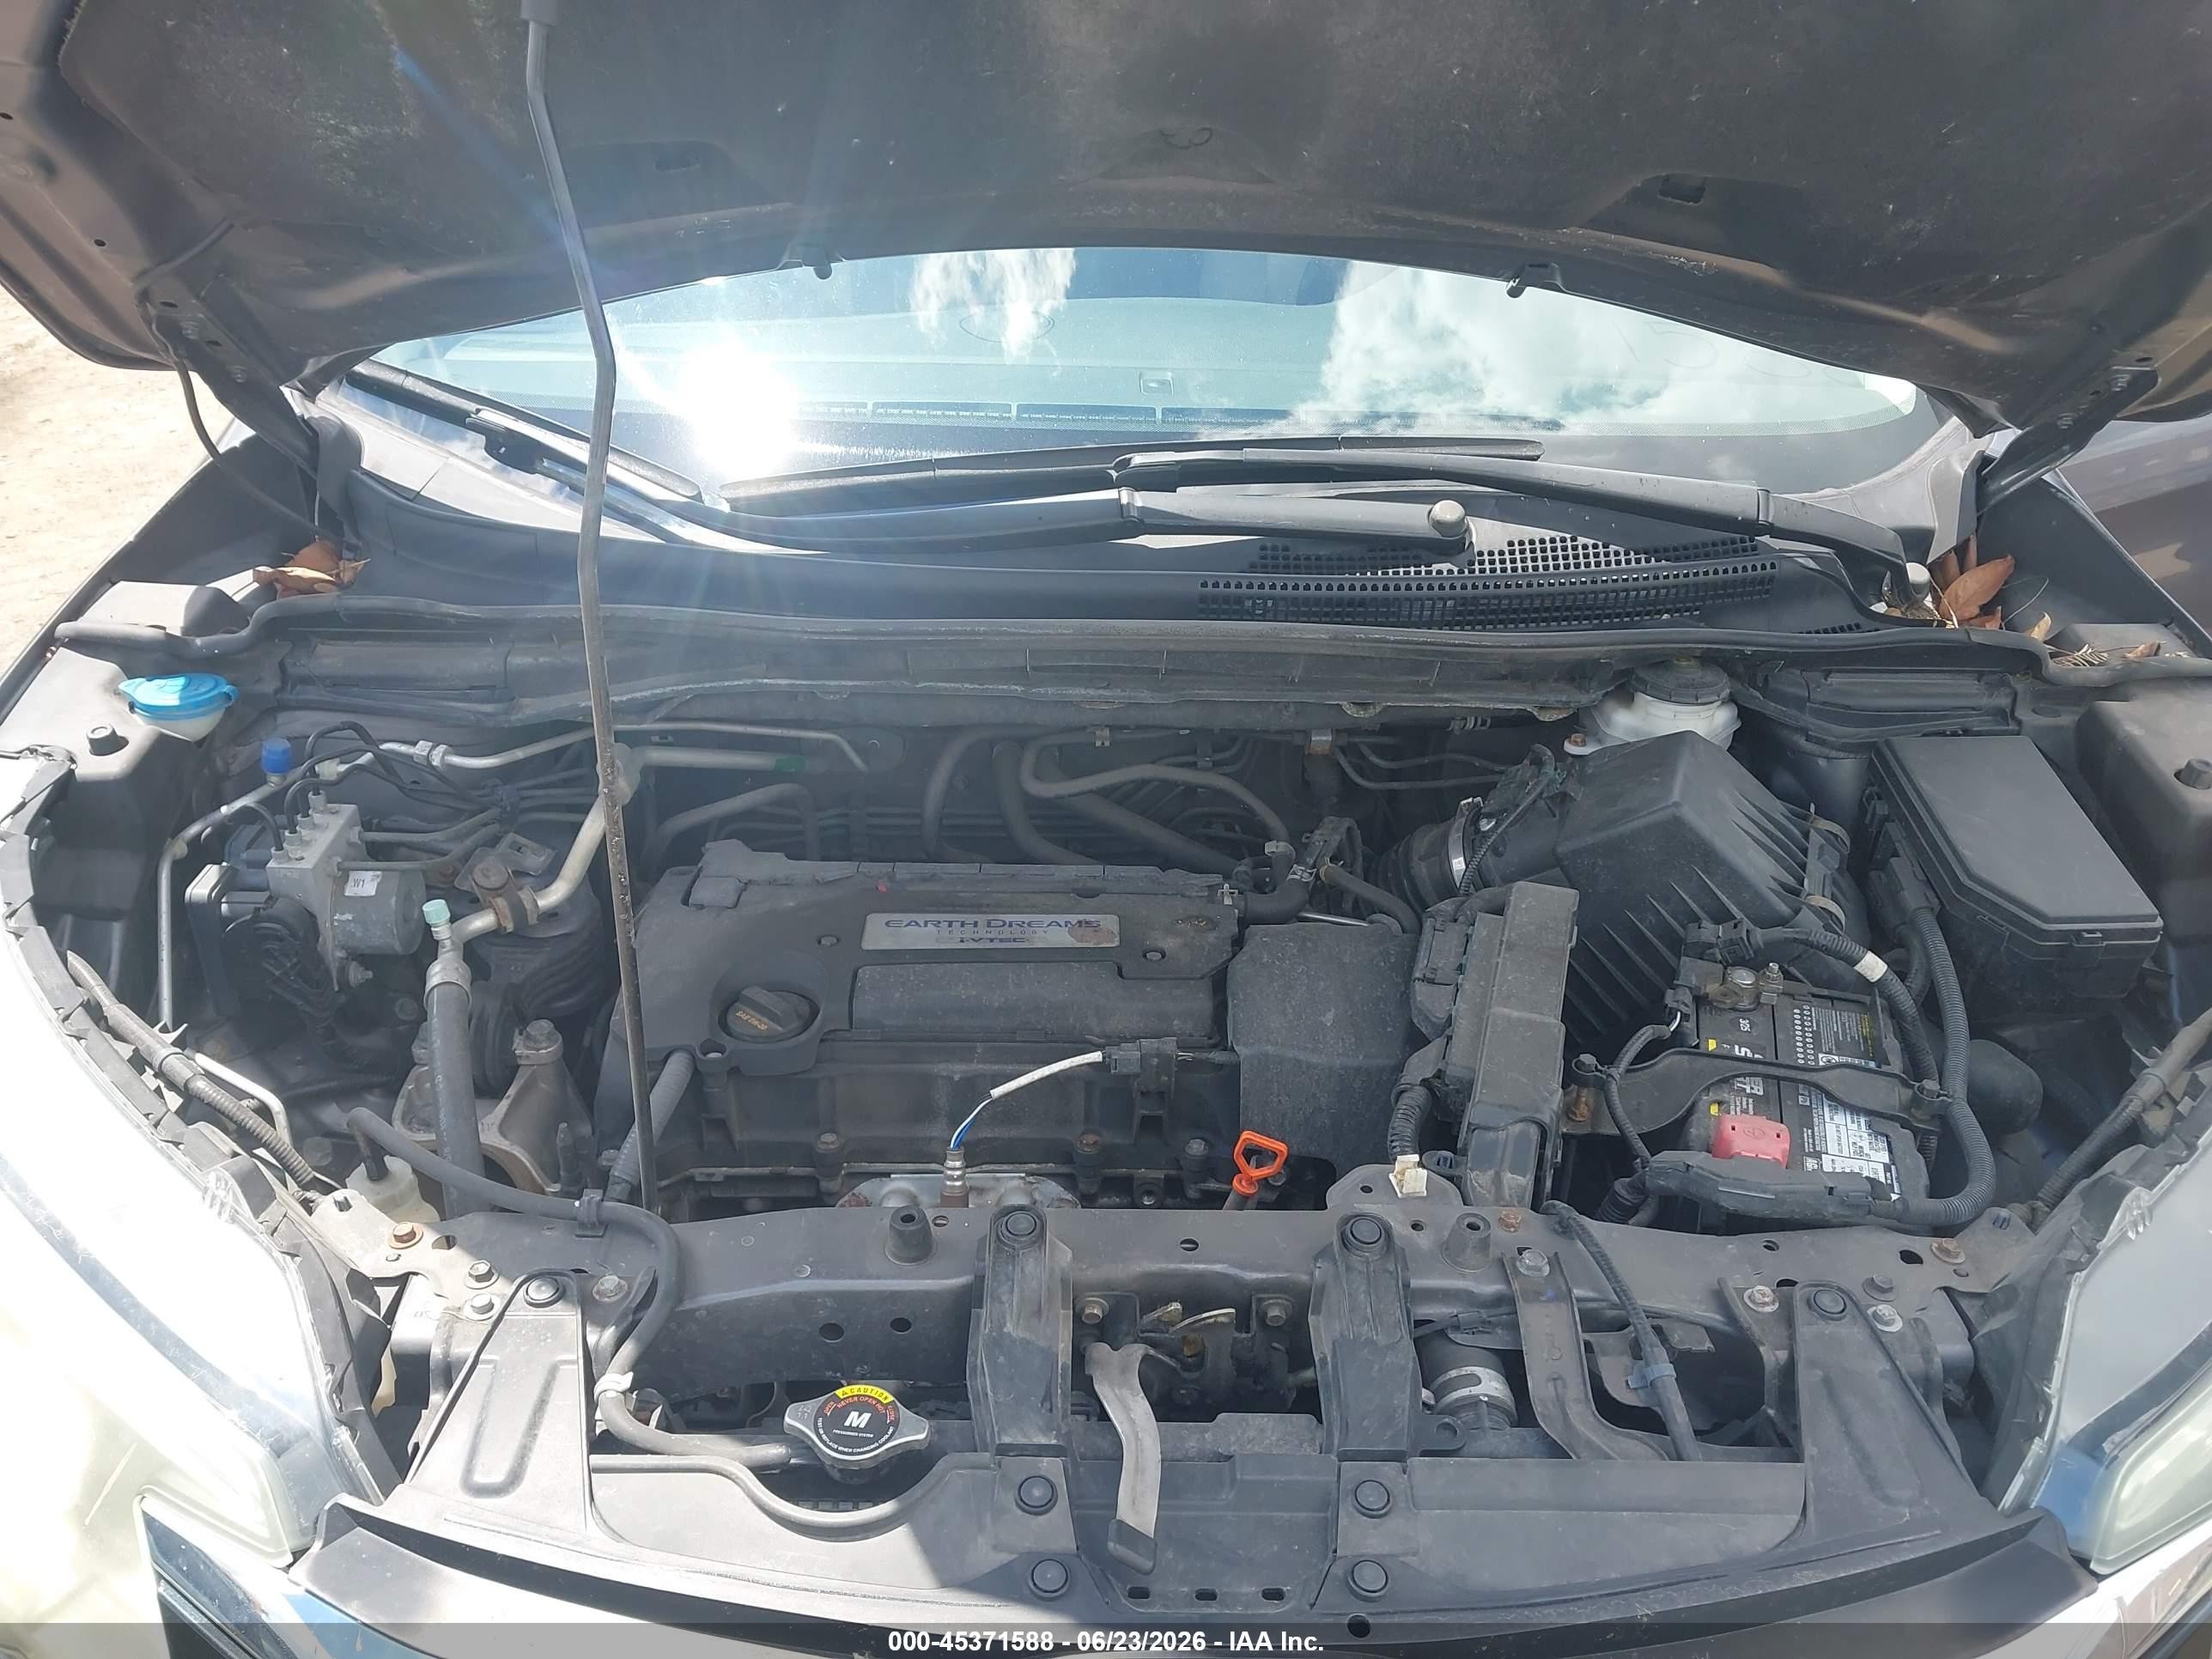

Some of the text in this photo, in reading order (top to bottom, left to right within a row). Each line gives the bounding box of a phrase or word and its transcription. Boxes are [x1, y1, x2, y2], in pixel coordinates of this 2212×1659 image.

[884, 919, 1101, 928] EARTH DREAMS
[1739, 1018, 1751, 1032] 325
[849, 1387, 889, 1402] CAUTION
[836, 1396, 859, 1408] NEVER
[859, 1396, 878, 1406] OPEN
[843, 1411, 872, 1428] M
